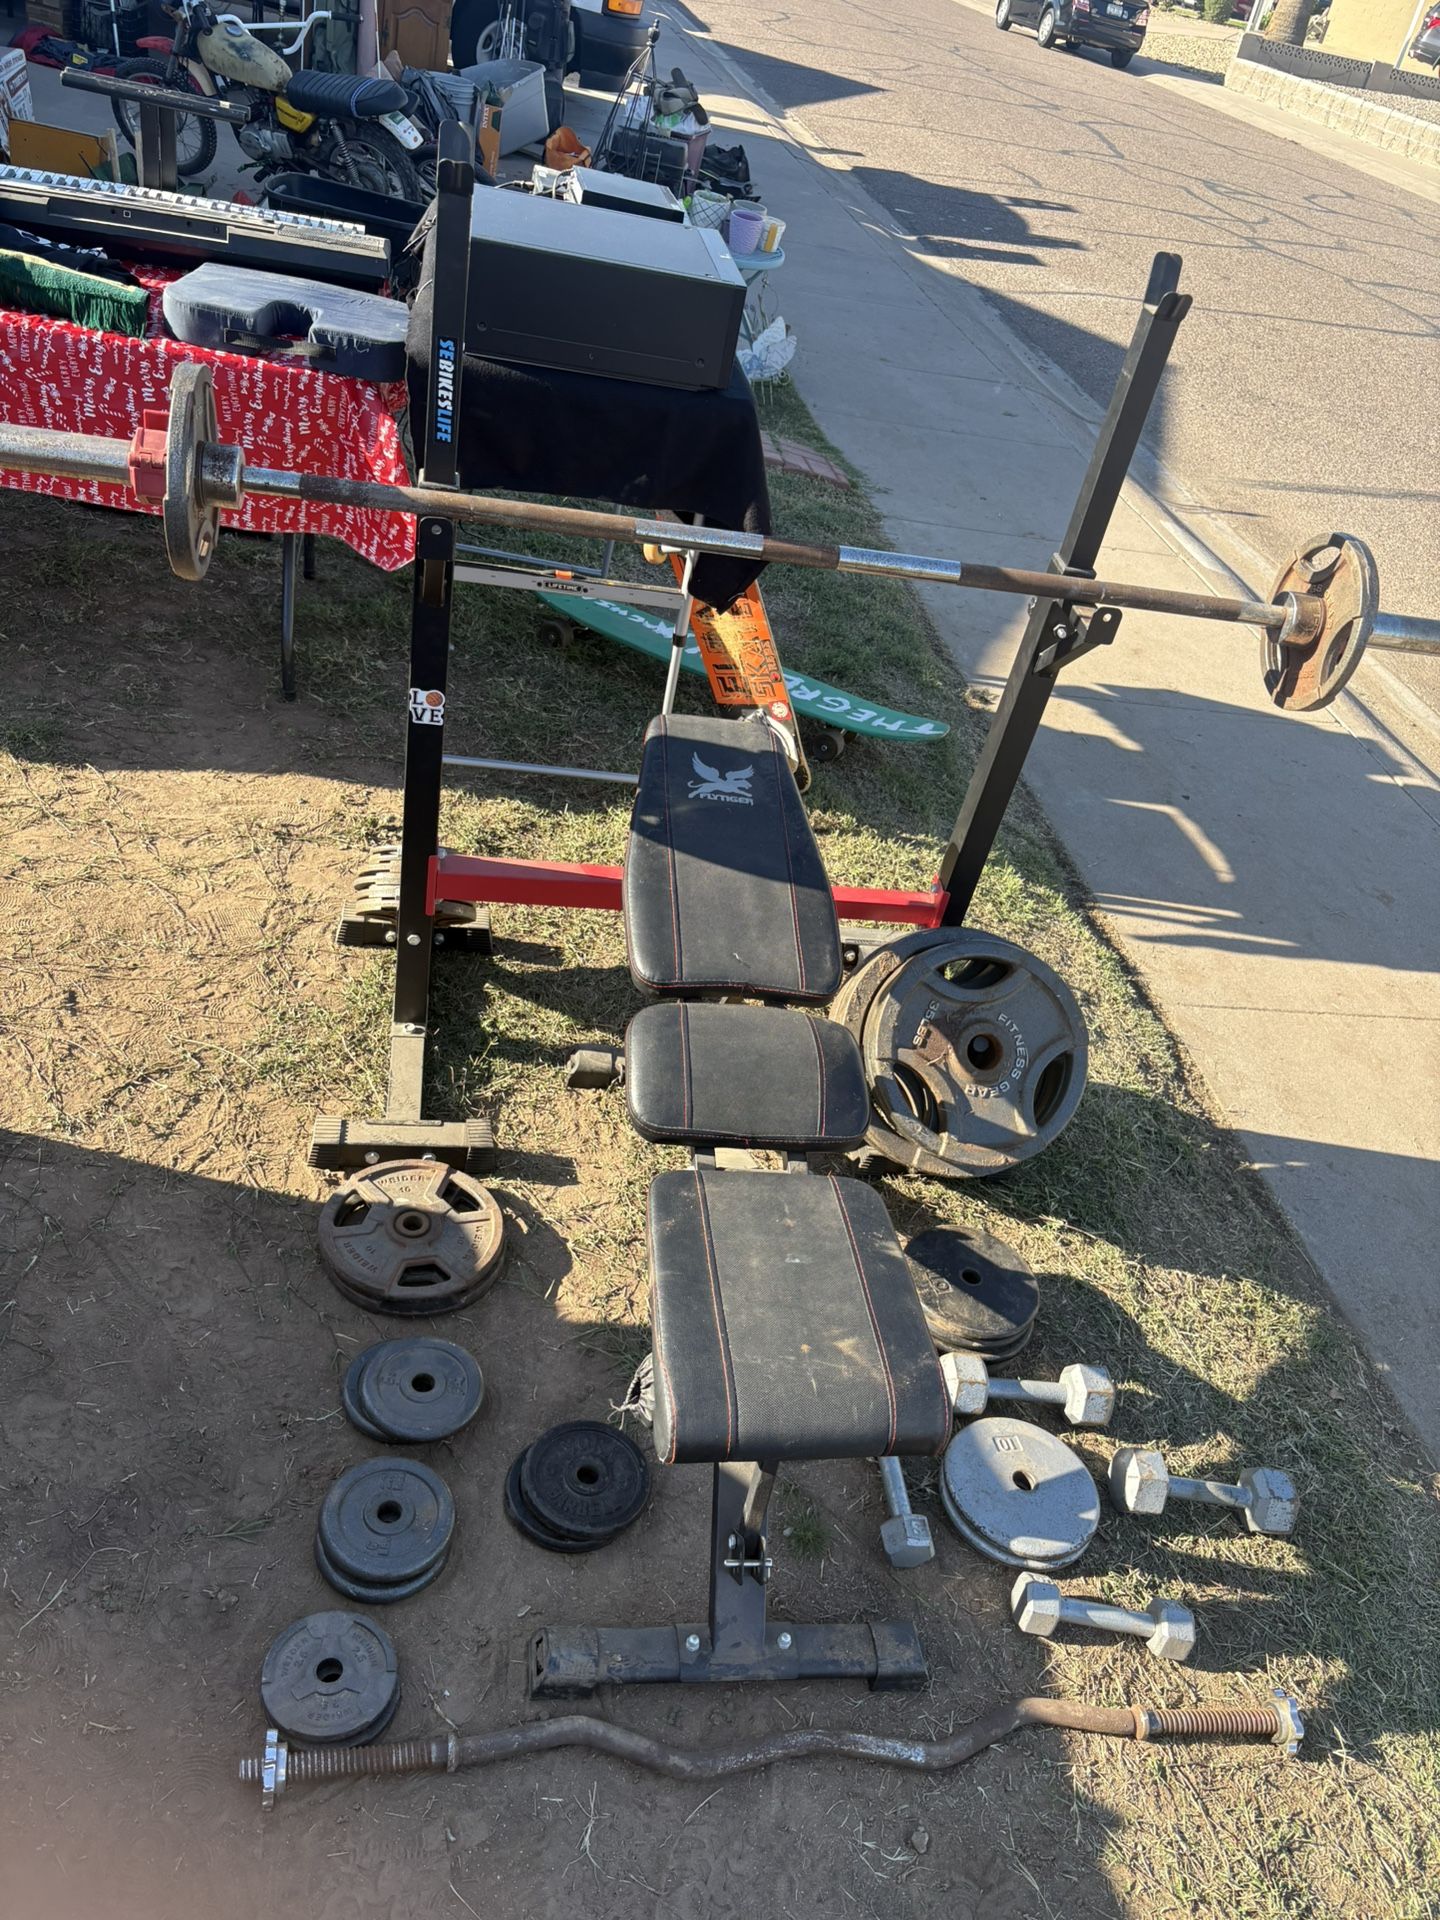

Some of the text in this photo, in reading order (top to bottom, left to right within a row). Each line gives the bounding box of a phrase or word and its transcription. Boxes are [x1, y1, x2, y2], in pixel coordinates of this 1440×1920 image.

[221, 395, 232, 422] MERRY
[965, 1012, 1026, 1098] FITNESS GEAR
